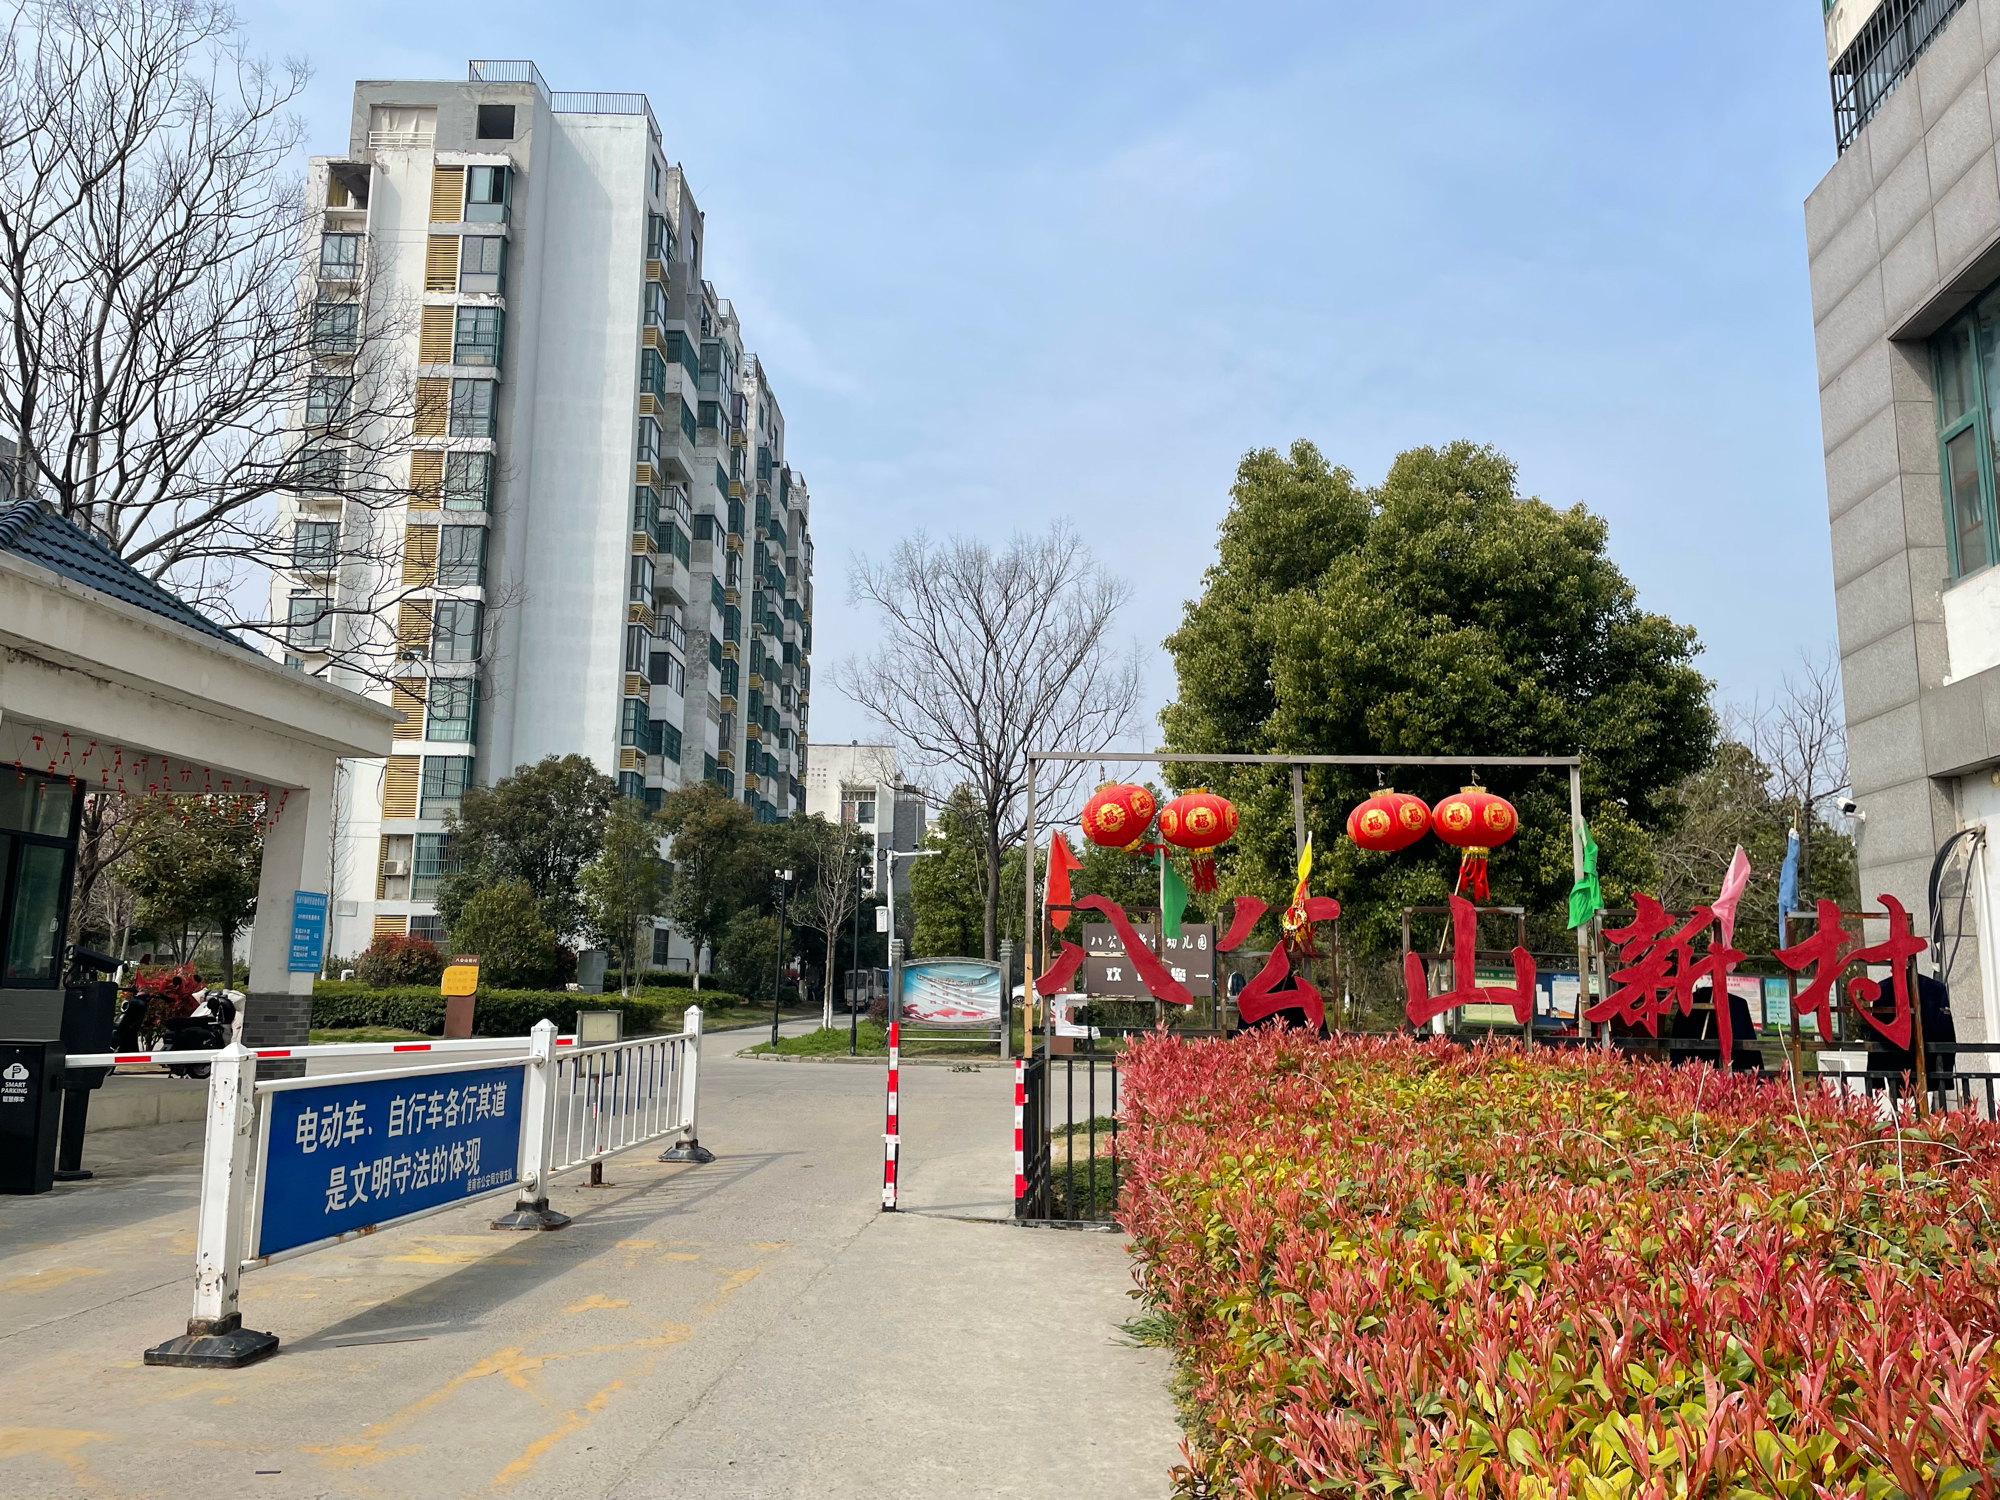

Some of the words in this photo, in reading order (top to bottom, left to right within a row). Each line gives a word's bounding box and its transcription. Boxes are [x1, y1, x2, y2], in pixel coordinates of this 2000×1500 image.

[1104, 809, 1118, 826] 福
[1194, 814, 1210, 828] 福
[1367, 815, 1382, 831] 福
[1408, 808, 1422, 823] 福
[1449, 809, 1464, 823] 福
[1492, 809, 1506, 823] 福
[1035, 892, 1928, 1068] 八公山新村
[295, 1080, 508, 1154] 电动车、自行车各行其道
[324, 1137, 482, 1215] 是文明守法的体现
